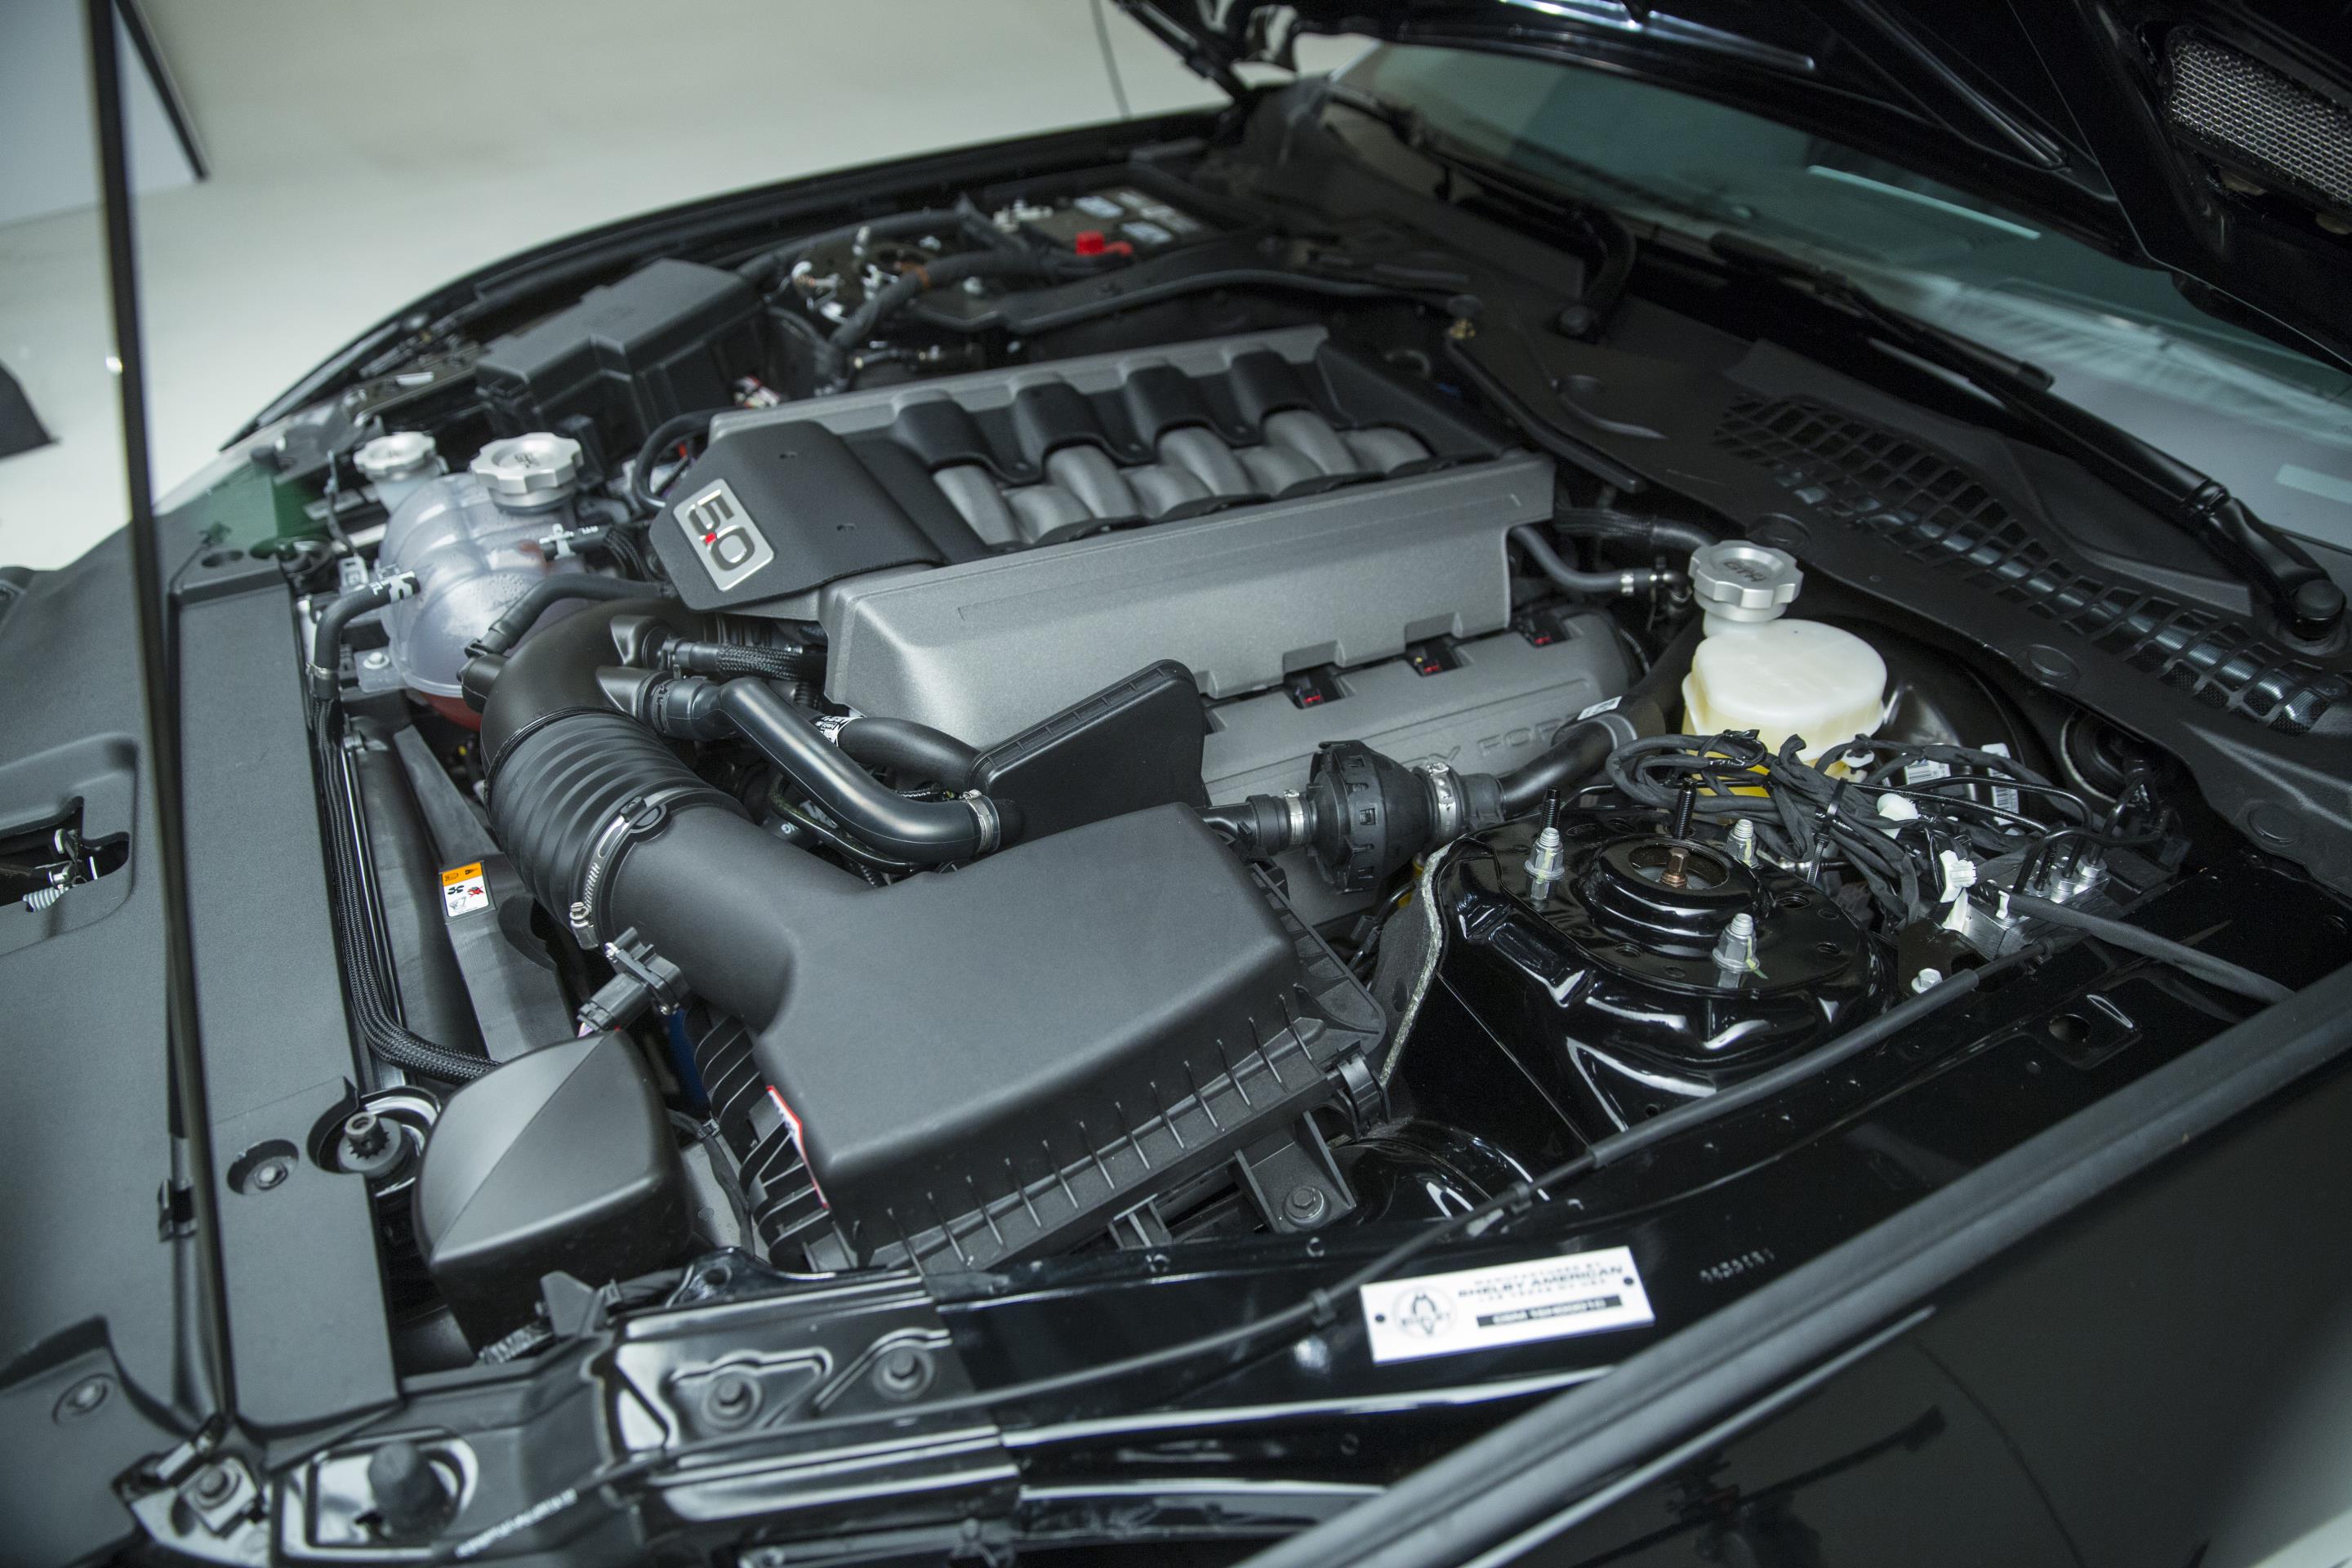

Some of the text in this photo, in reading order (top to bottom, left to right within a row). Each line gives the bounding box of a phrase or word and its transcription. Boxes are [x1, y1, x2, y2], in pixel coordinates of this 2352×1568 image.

[685, 488, 755, 572] 5.0
[1476, 712, 1577, 758] FOR
[1530, 1266, 1624, 1286] AMERICAN
